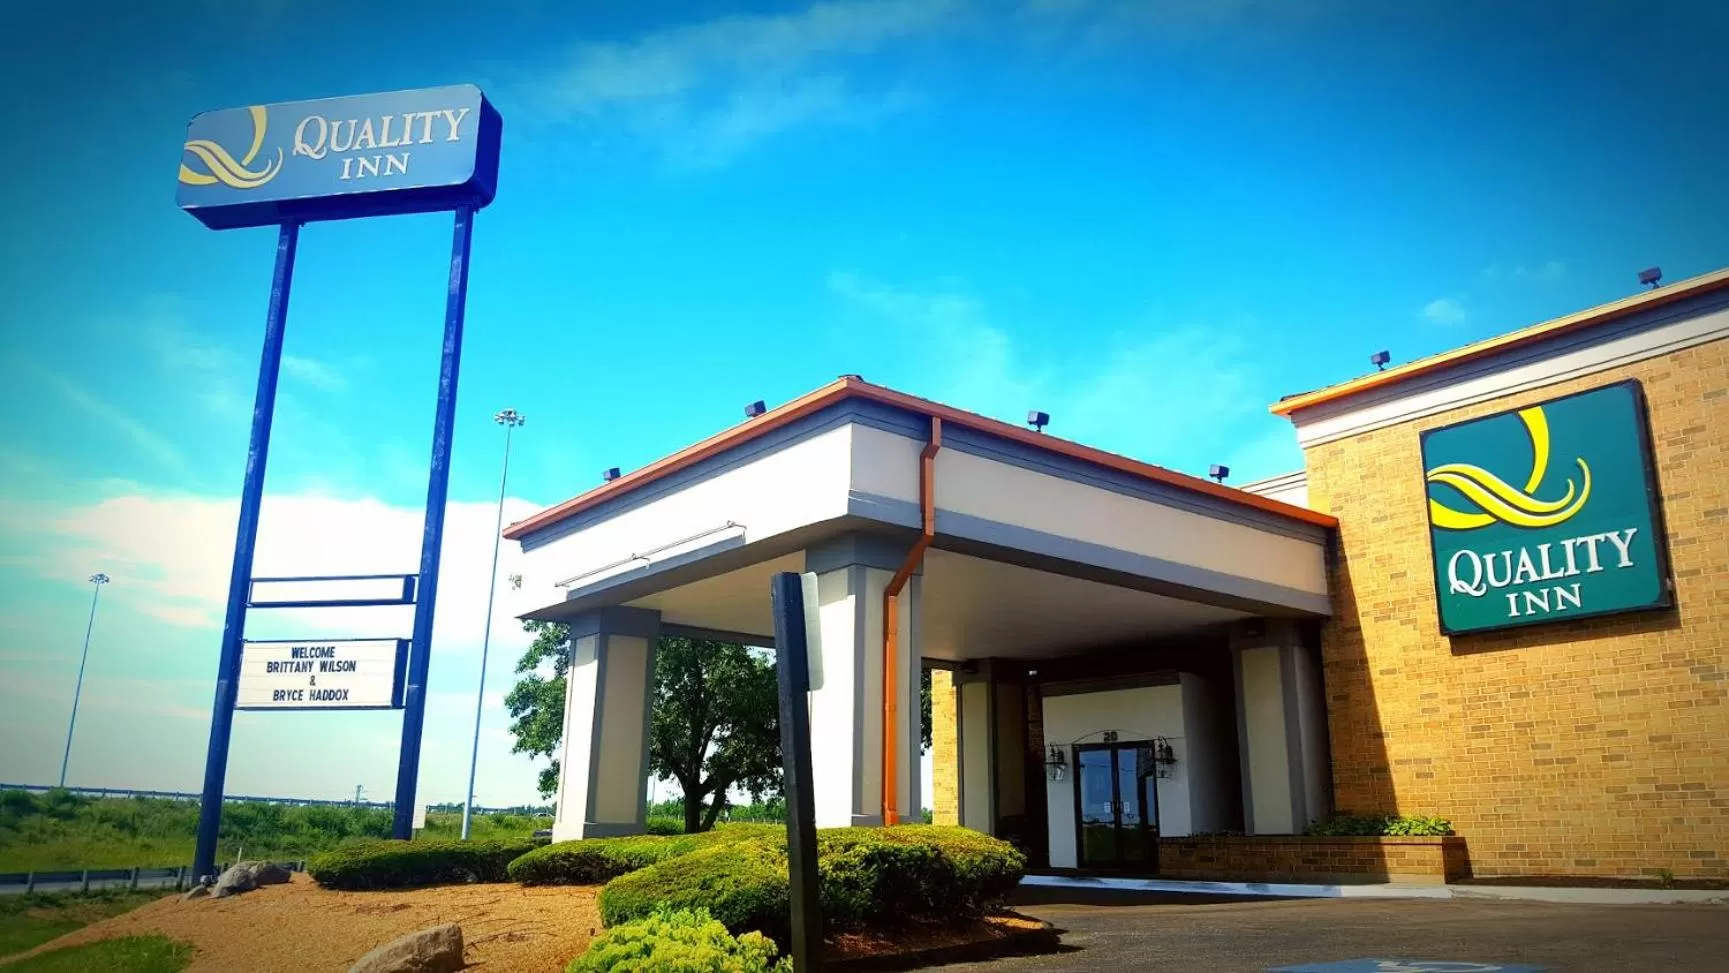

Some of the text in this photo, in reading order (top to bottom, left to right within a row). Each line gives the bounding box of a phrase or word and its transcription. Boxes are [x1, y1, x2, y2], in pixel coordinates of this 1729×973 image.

[292, 108, 471, 160] QUALITY
[339, 153, 411, 180] INN
[1447, 528, 1638, 597] QUALITY
[1506, 583, 1582, 618] INN
[291, 646, 336, 659] WELCOME
[266, 660, 357, 673] BRITTANY WILSON
[309, 675, 316, 686] &
[272, 689, 349, 701] BRYCE HADDOX
